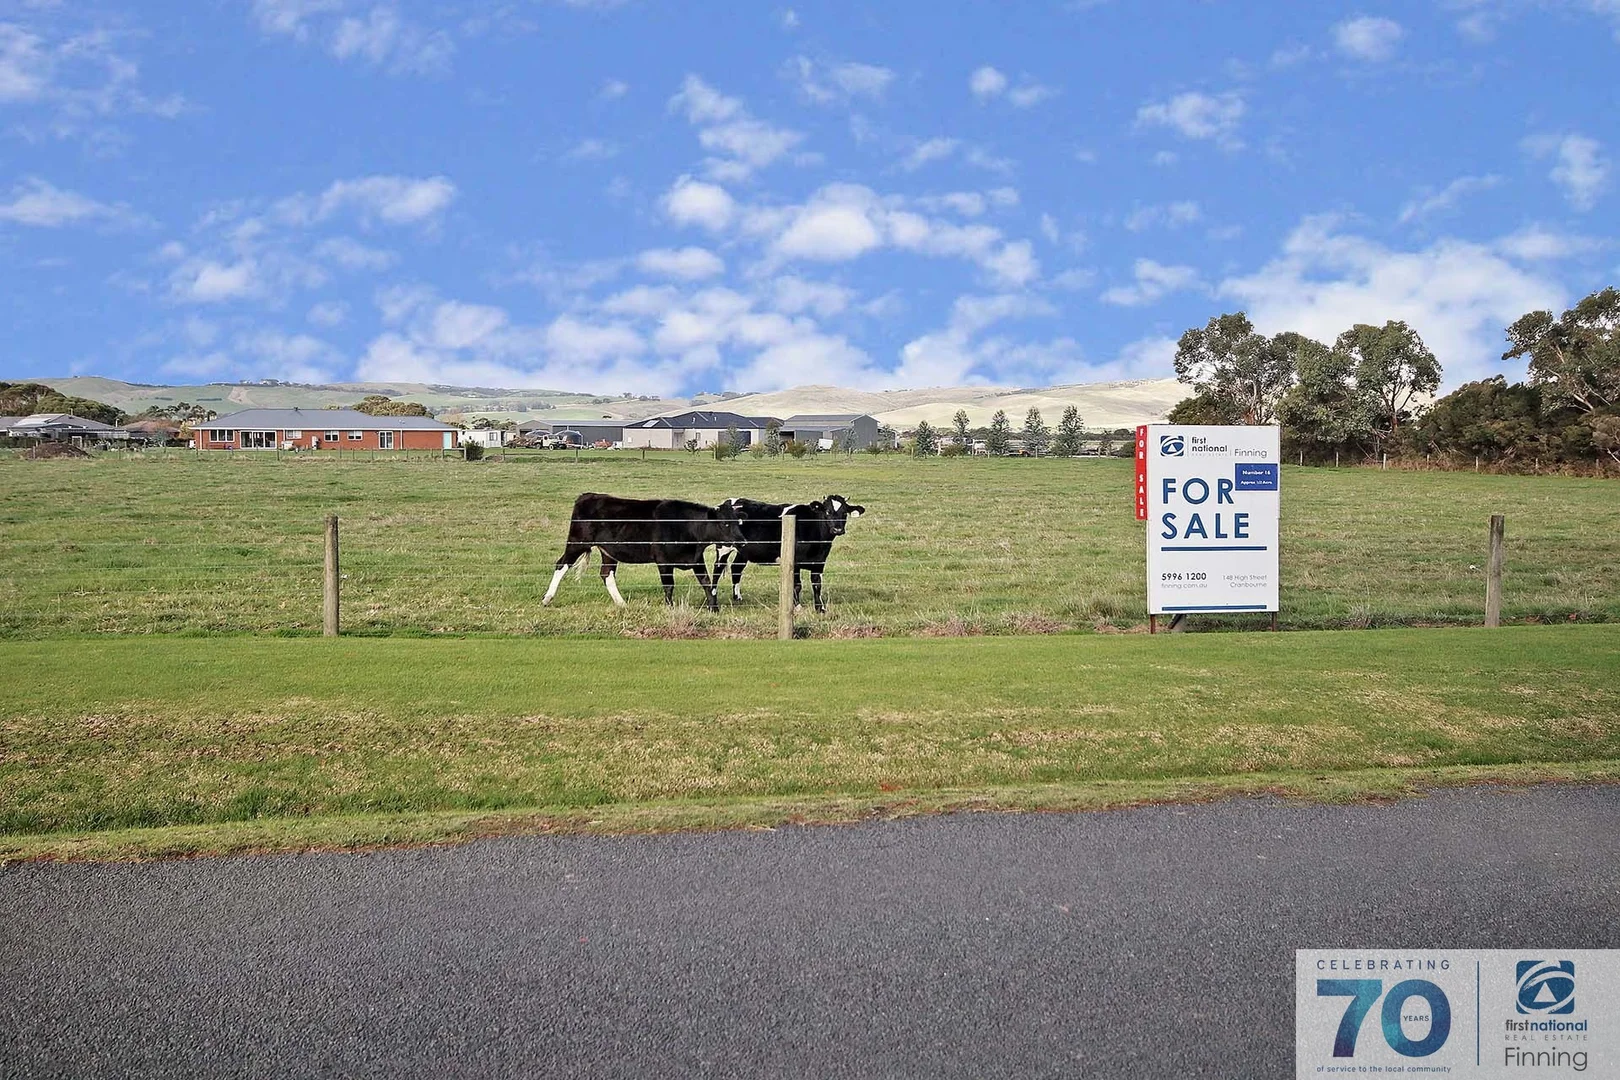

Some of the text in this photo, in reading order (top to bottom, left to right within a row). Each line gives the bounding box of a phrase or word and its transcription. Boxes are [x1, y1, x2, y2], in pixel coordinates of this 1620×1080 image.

[1191, 436, 1207, 444] first
[1191, 444, 1228, 452] national
[1234, 448, 1268, 459] Finning
[1162, 478, 1235, 505] FOR
[1161, 512, 1249, 539] SALE
[1161, 572, 1207, 581] 5996 1200
[1234, 574, 1249, 582] High
